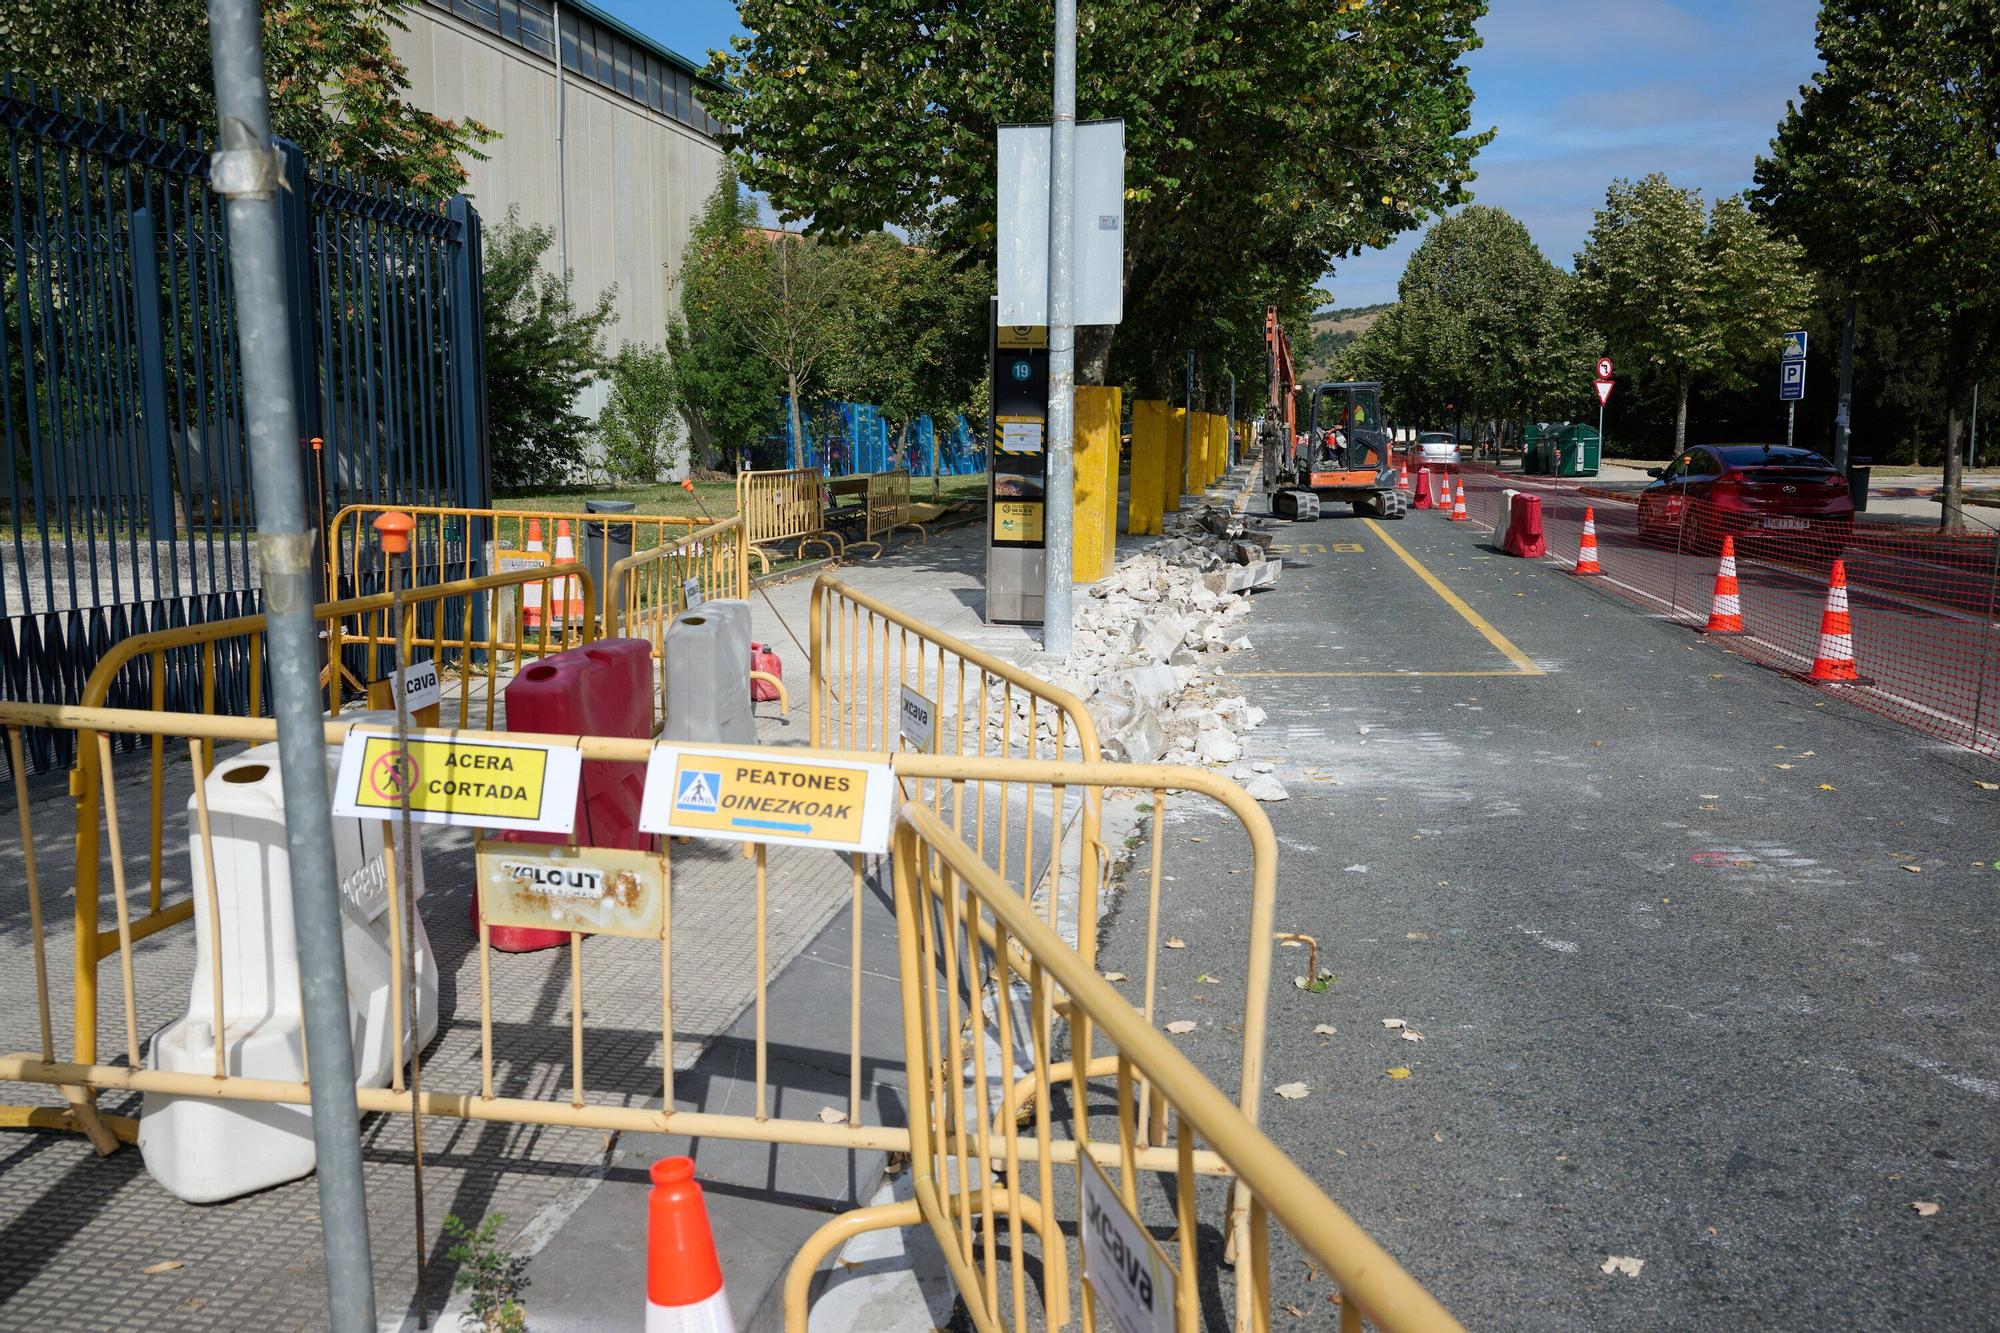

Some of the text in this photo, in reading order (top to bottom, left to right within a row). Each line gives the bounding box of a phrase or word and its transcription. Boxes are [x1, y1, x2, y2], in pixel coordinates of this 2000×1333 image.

[1014, 365, 1029, 378] 19
[1788, 368, 1797, 381] P
[904, 698, 928, 725] xcava
[445, 752, 514, 772] ACERA
[428, 780, 528, 801] CORTADA
[736, 768, 850, 792] PEATONES
[721, 794, 853, 819] OINEZKOAK
[1086, 1187, 1153, 1312] xcava
